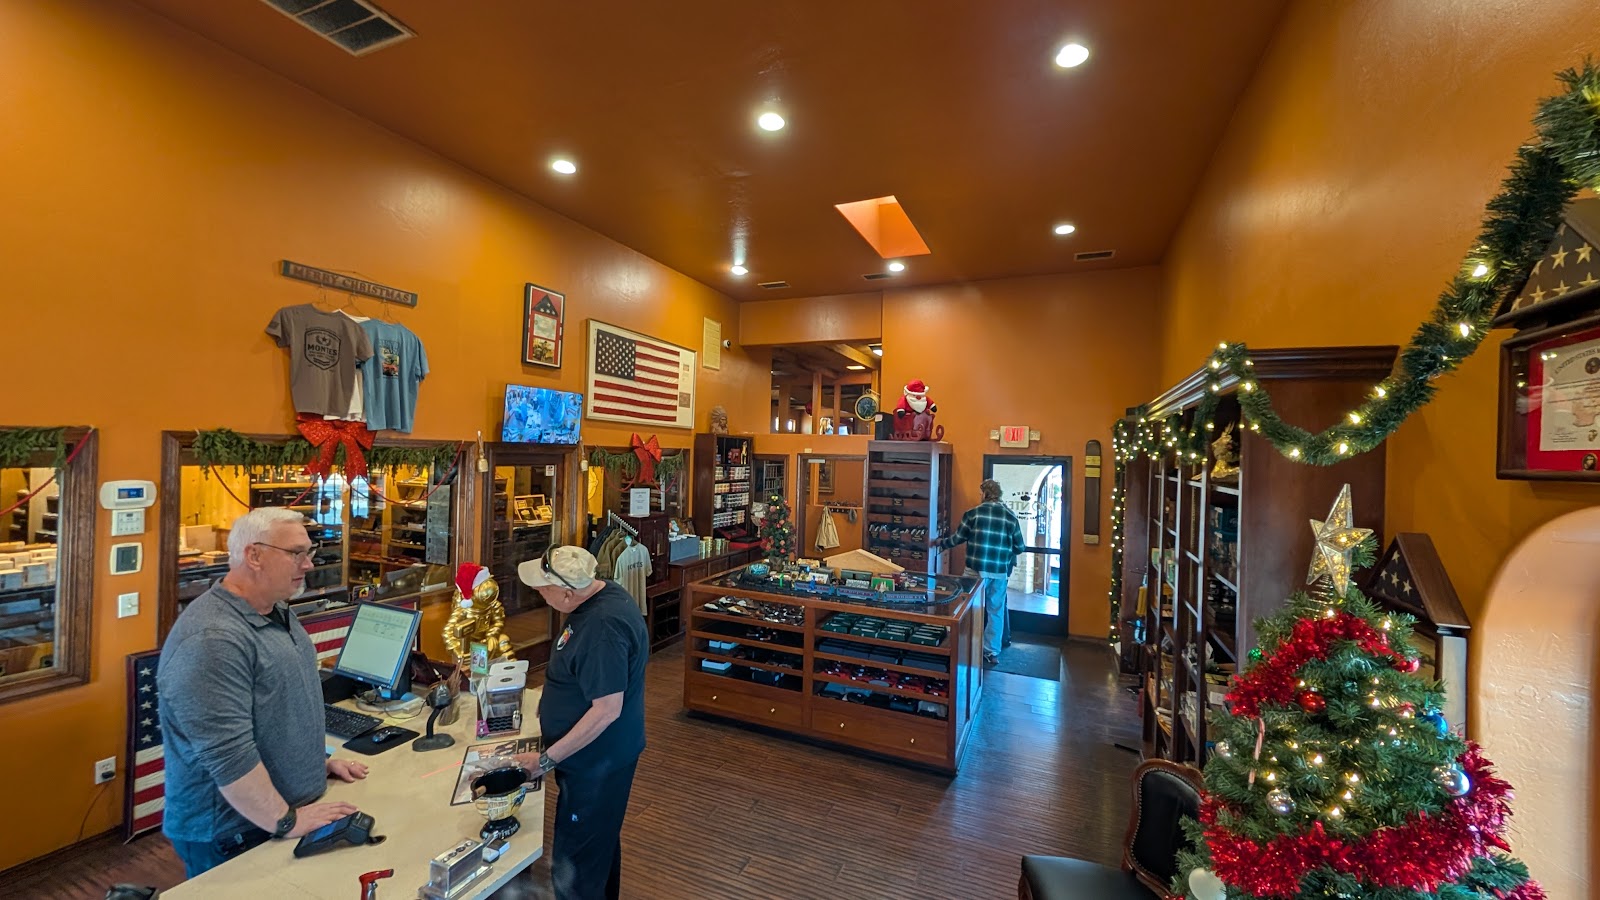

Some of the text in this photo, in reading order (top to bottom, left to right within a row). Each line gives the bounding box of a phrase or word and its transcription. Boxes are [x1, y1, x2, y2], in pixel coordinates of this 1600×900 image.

[292, 265, 410, 302] MERRY CHRISTMAS
[1005, 427, 1024, 441] EXIT
